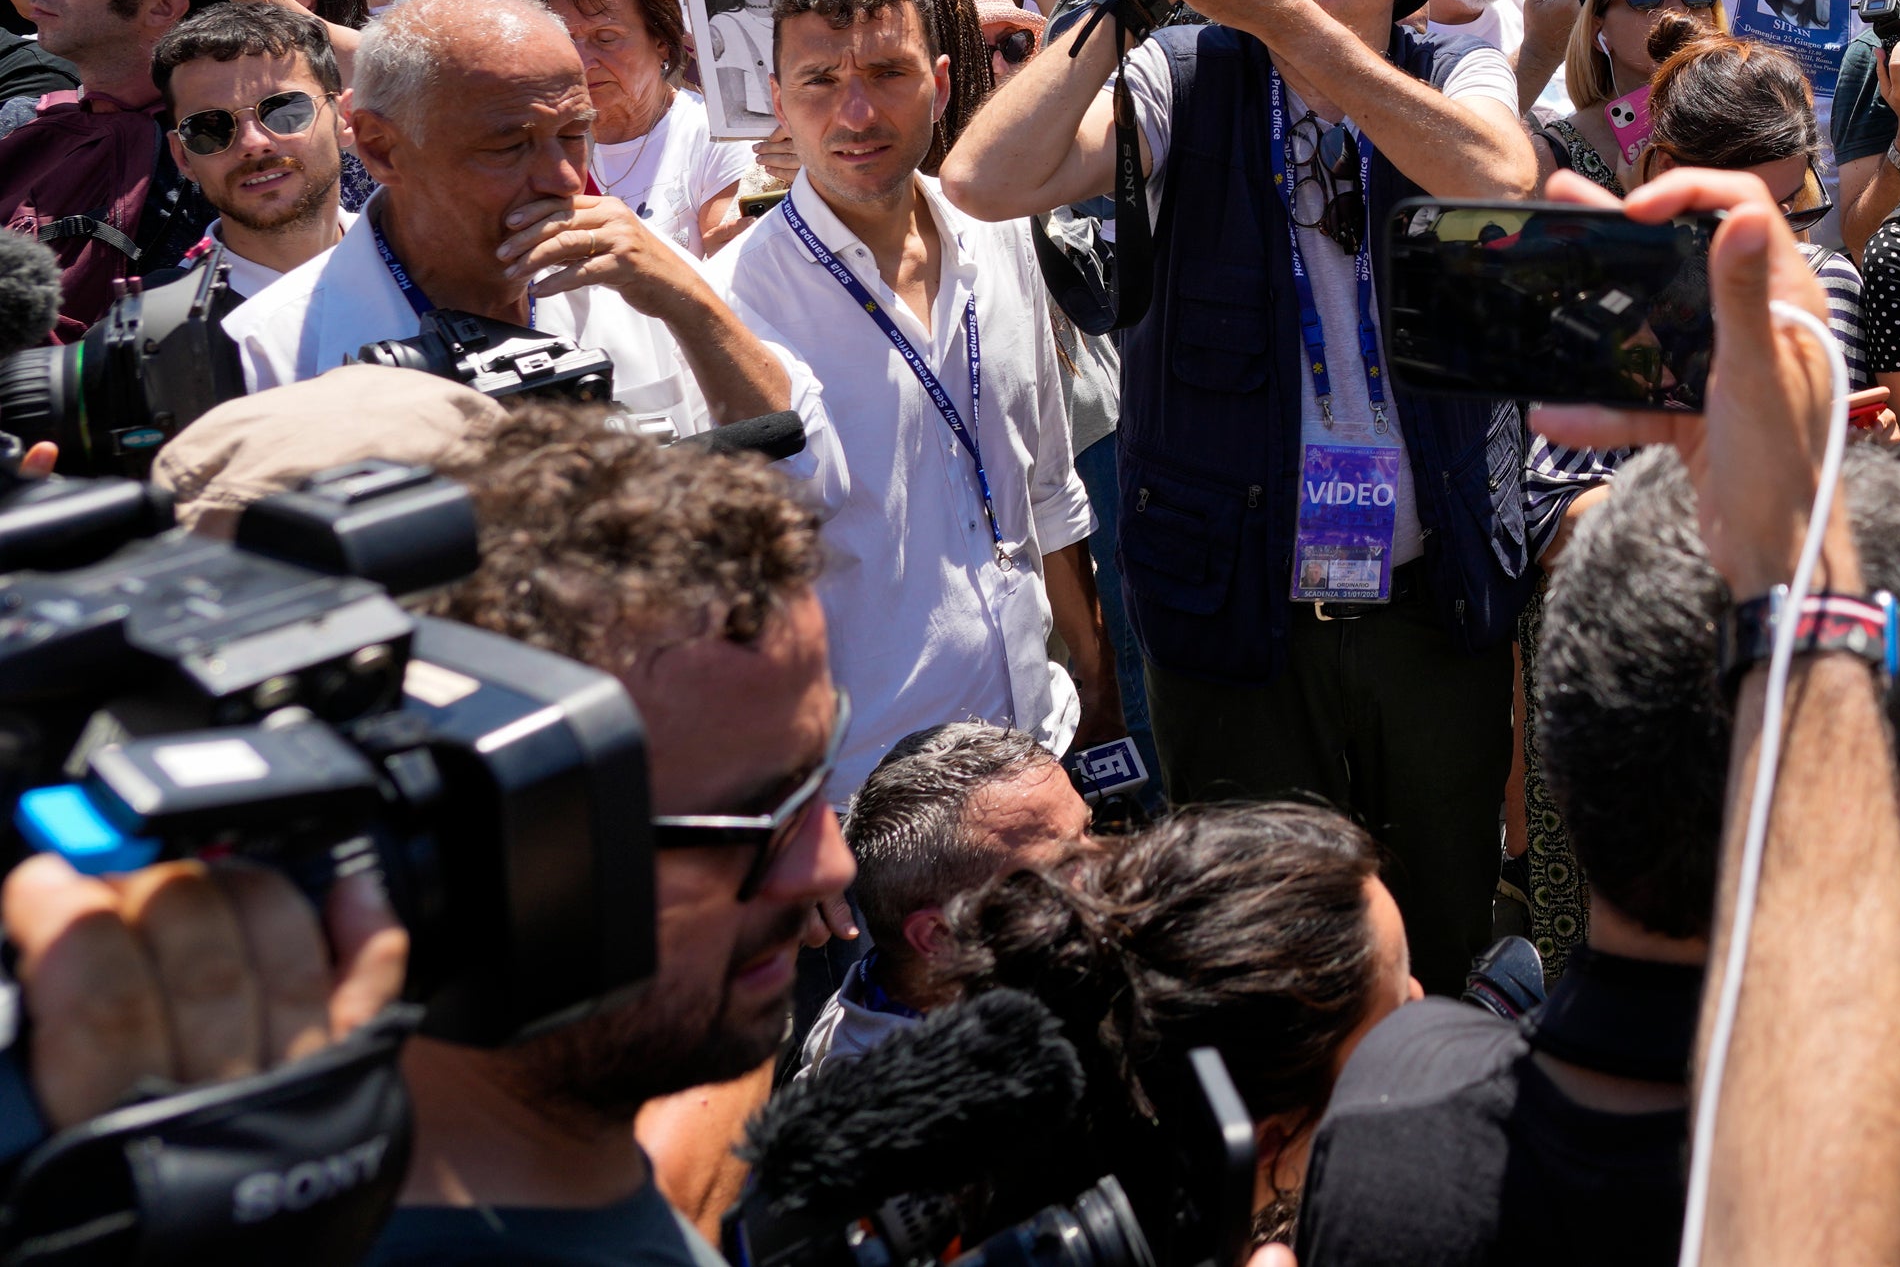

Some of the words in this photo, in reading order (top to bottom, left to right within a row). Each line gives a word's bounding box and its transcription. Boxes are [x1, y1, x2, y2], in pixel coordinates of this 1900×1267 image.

[1744, 24, 1781, 42] Domenica
[1783, 35, 1793, 44] 25
[1794, 38, 1822, 50] Giugno
[1773, 18, 1811, 38] SIT-IN
[1816, 56, 1833, 65] Roma
[1823, 65, 1840, 73] Pietro
[1272, 79, 1281, 107] Press
[1273, 109, 1283, 141] Office
[1123, 143, 1137, 207] SONY
[783, 202, 801, 229] Santa
[377, 239, 394, 263] See
[800, 229, 833, 265] Stampa
[390, 263, 413, 291] Holy
[831, 262, 853, 285] Sala
[1292, 253, 1304, 277] Holy
[891, 329, 915, 361] Office
[969, 314, 979, 359] Stampa
[912, 360, 935, 389] Press
[972, 361, 980, 395] Santa
[931, 387, 948, 408] See
[944, 406, 963, 432] Holy
[1306, 481, 1394, 507] VIDEO
[1304, 590, 1339, 598] SCADENZA
[232, 1133, 390, 1224] SONY
